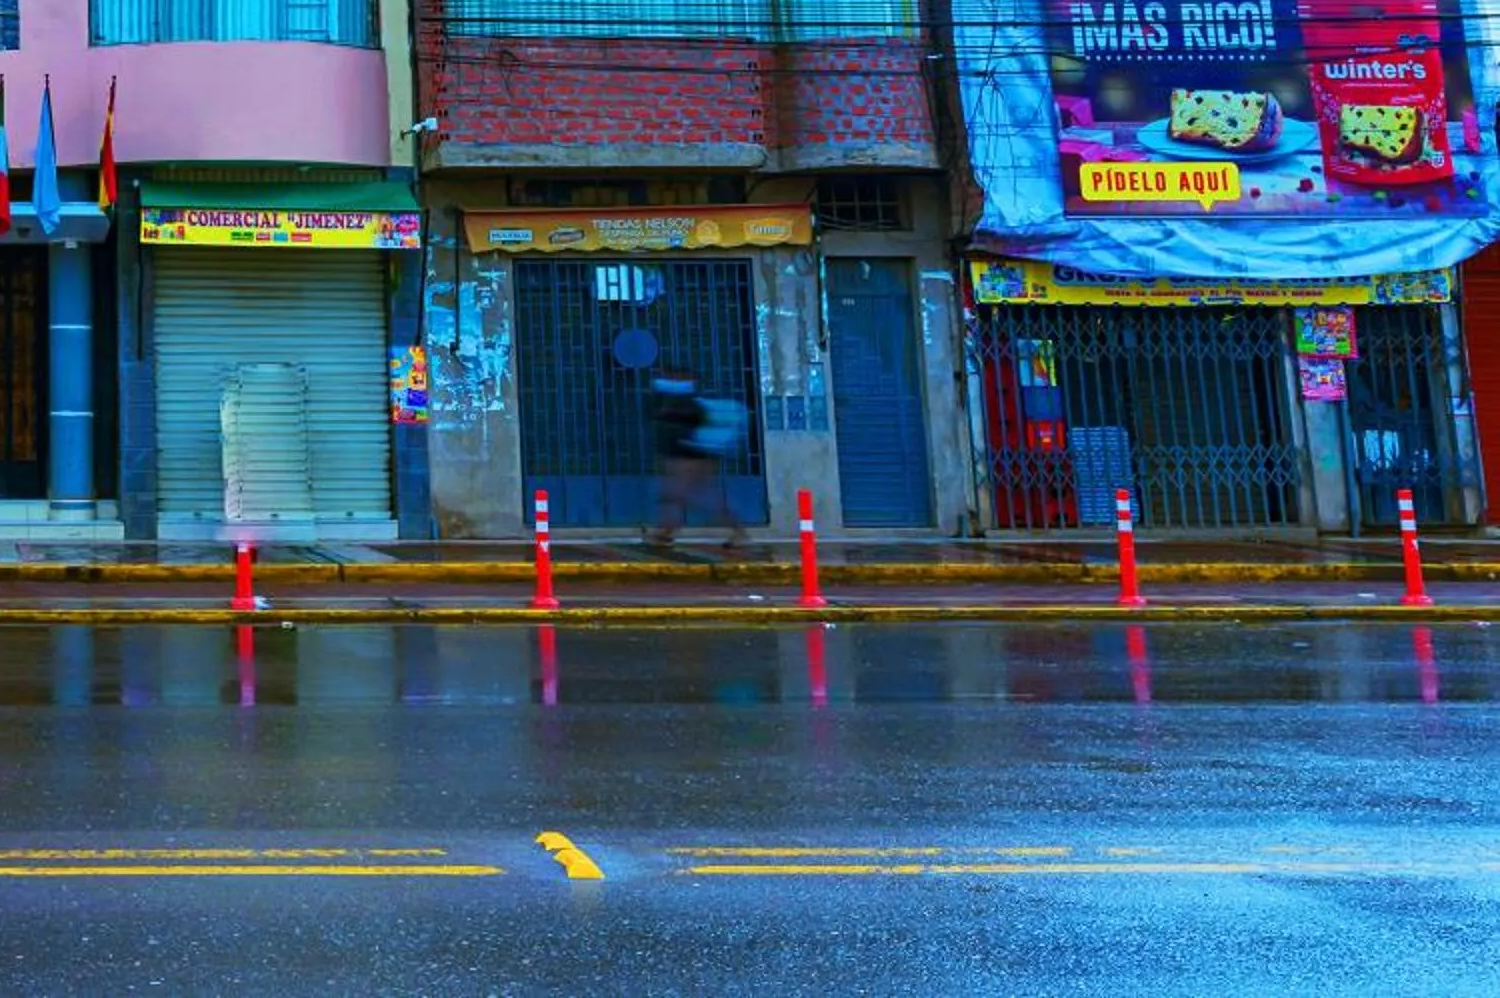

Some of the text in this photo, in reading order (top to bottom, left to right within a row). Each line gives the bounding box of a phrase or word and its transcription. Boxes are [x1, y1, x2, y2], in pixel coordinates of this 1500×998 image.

[1324, 58, 1427, 79] winter's
[1092, 165, 1232, 194] PÍDELO AQUÍ
[187, 211, 282, 228] COMERCIAL
